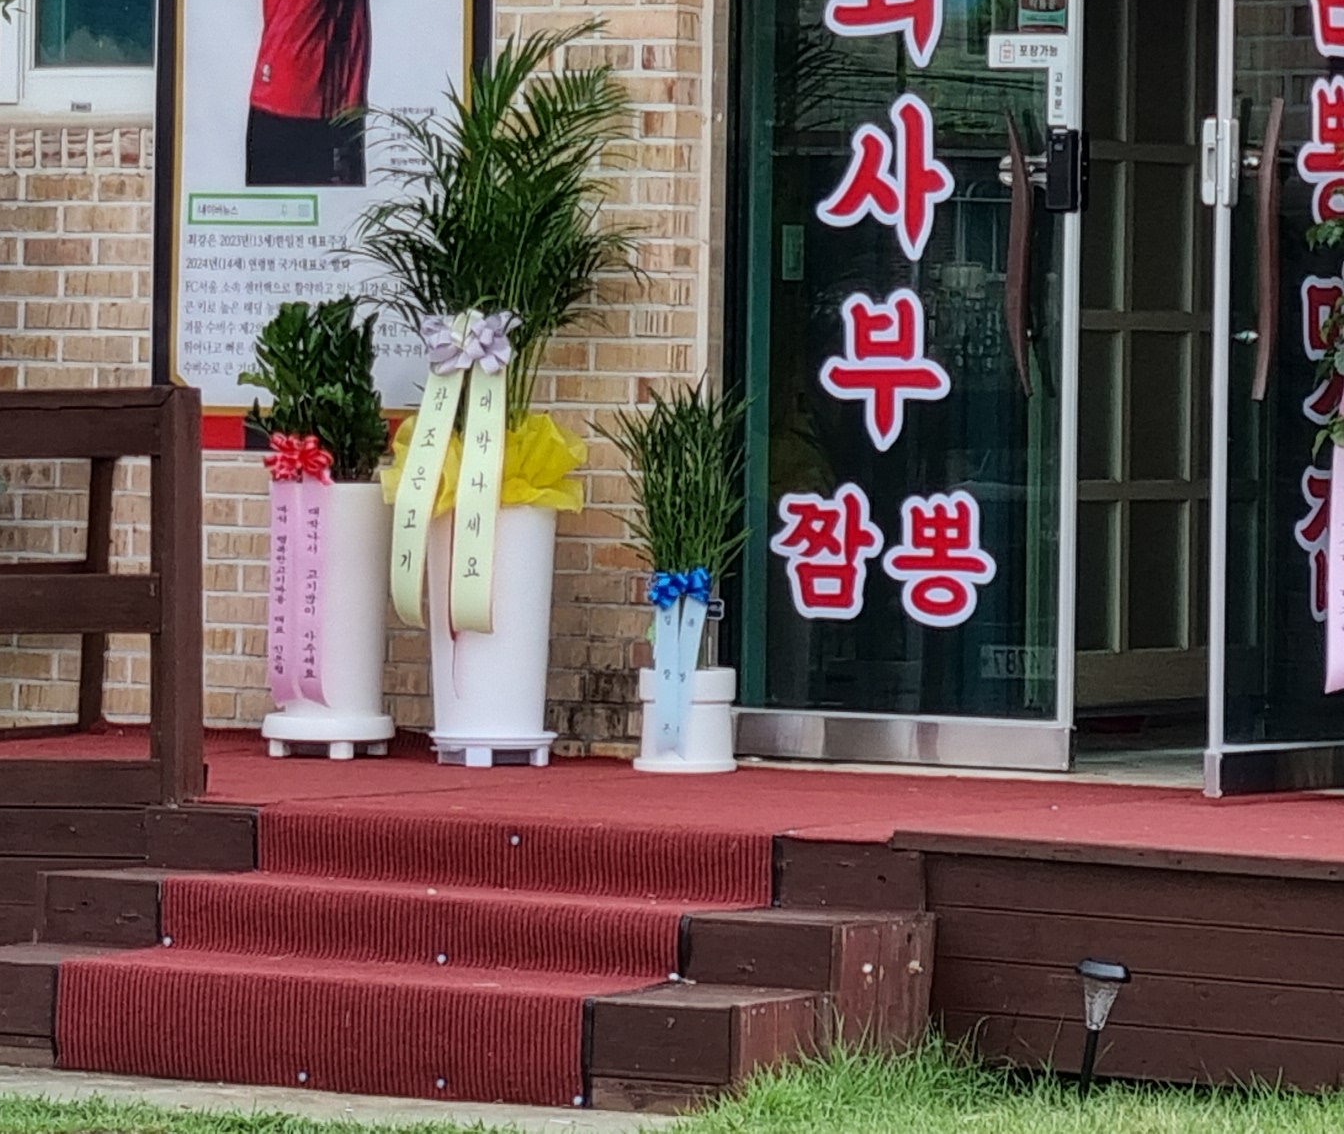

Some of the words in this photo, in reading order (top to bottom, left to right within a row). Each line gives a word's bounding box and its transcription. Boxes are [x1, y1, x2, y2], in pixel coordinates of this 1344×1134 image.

[1019, 44, 1058, 57] 포장가능
[463, 389, 494, 579] 대박나세요
[773, 485, 993, 624] 짬뽕
